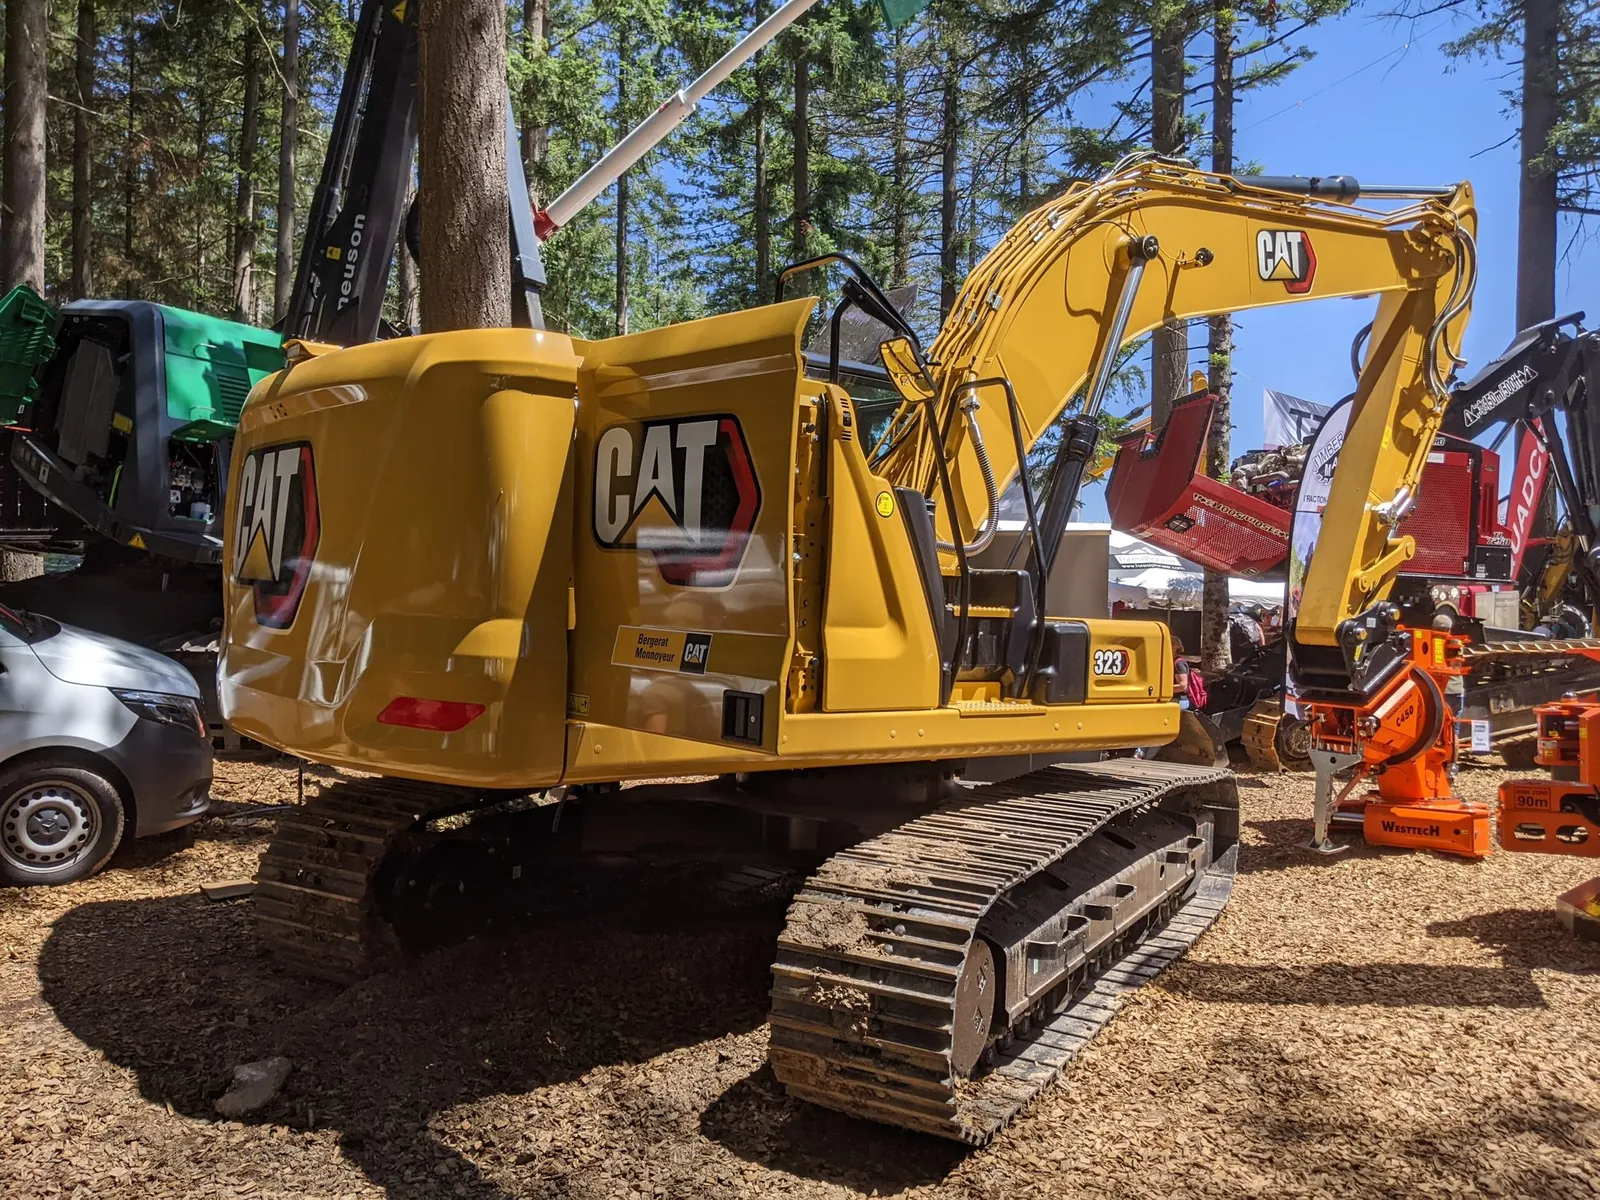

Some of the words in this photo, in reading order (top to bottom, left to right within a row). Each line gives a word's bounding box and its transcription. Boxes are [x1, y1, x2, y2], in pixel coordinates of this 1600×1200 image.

[1256, 230, 1303, 280] CAT
[595, 419, 719, 545] CAT
[233, 447, 301, 582] CAT
[637, 633, 669, 648] Bergerat
[634, 647, 675, 664] Monnoyeur
[684, 642, 707, 664] CAT
[1094, 650, 1122, 675] 323
[1517, 796, 1548, 807] 90m
